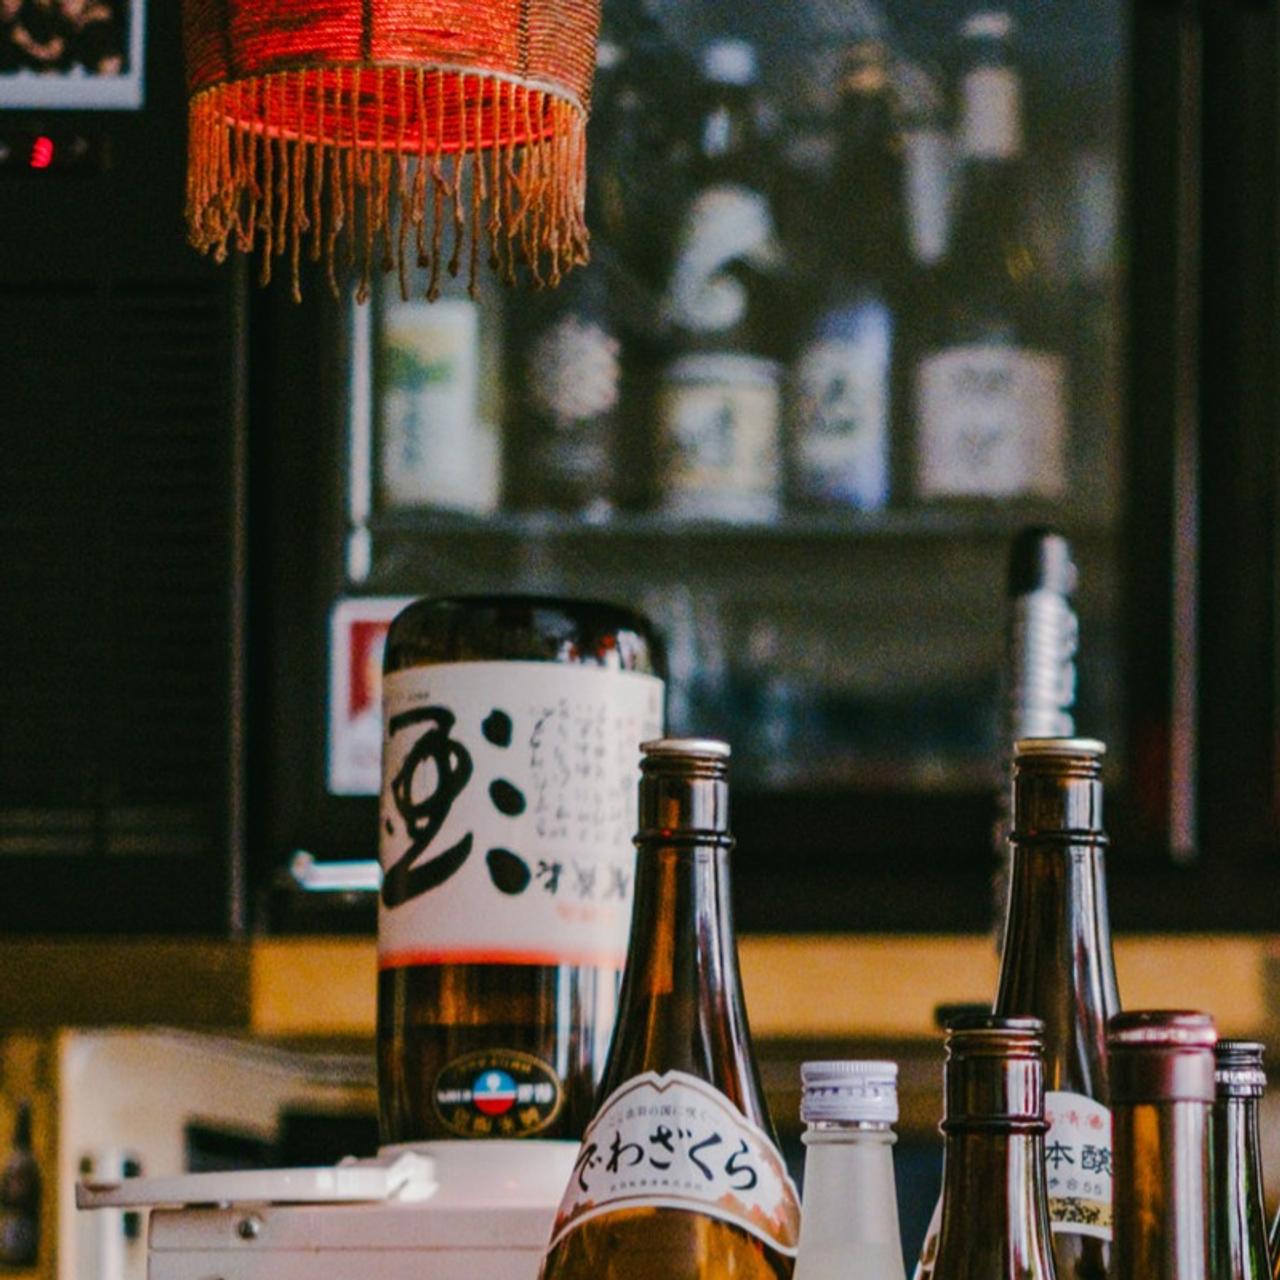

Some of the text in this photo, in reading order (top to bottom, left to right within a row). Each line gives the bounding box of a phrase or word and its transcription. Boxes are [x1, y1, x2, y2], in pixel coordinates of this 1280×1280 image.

[575, 1124, 758, 1194] でわざくら
